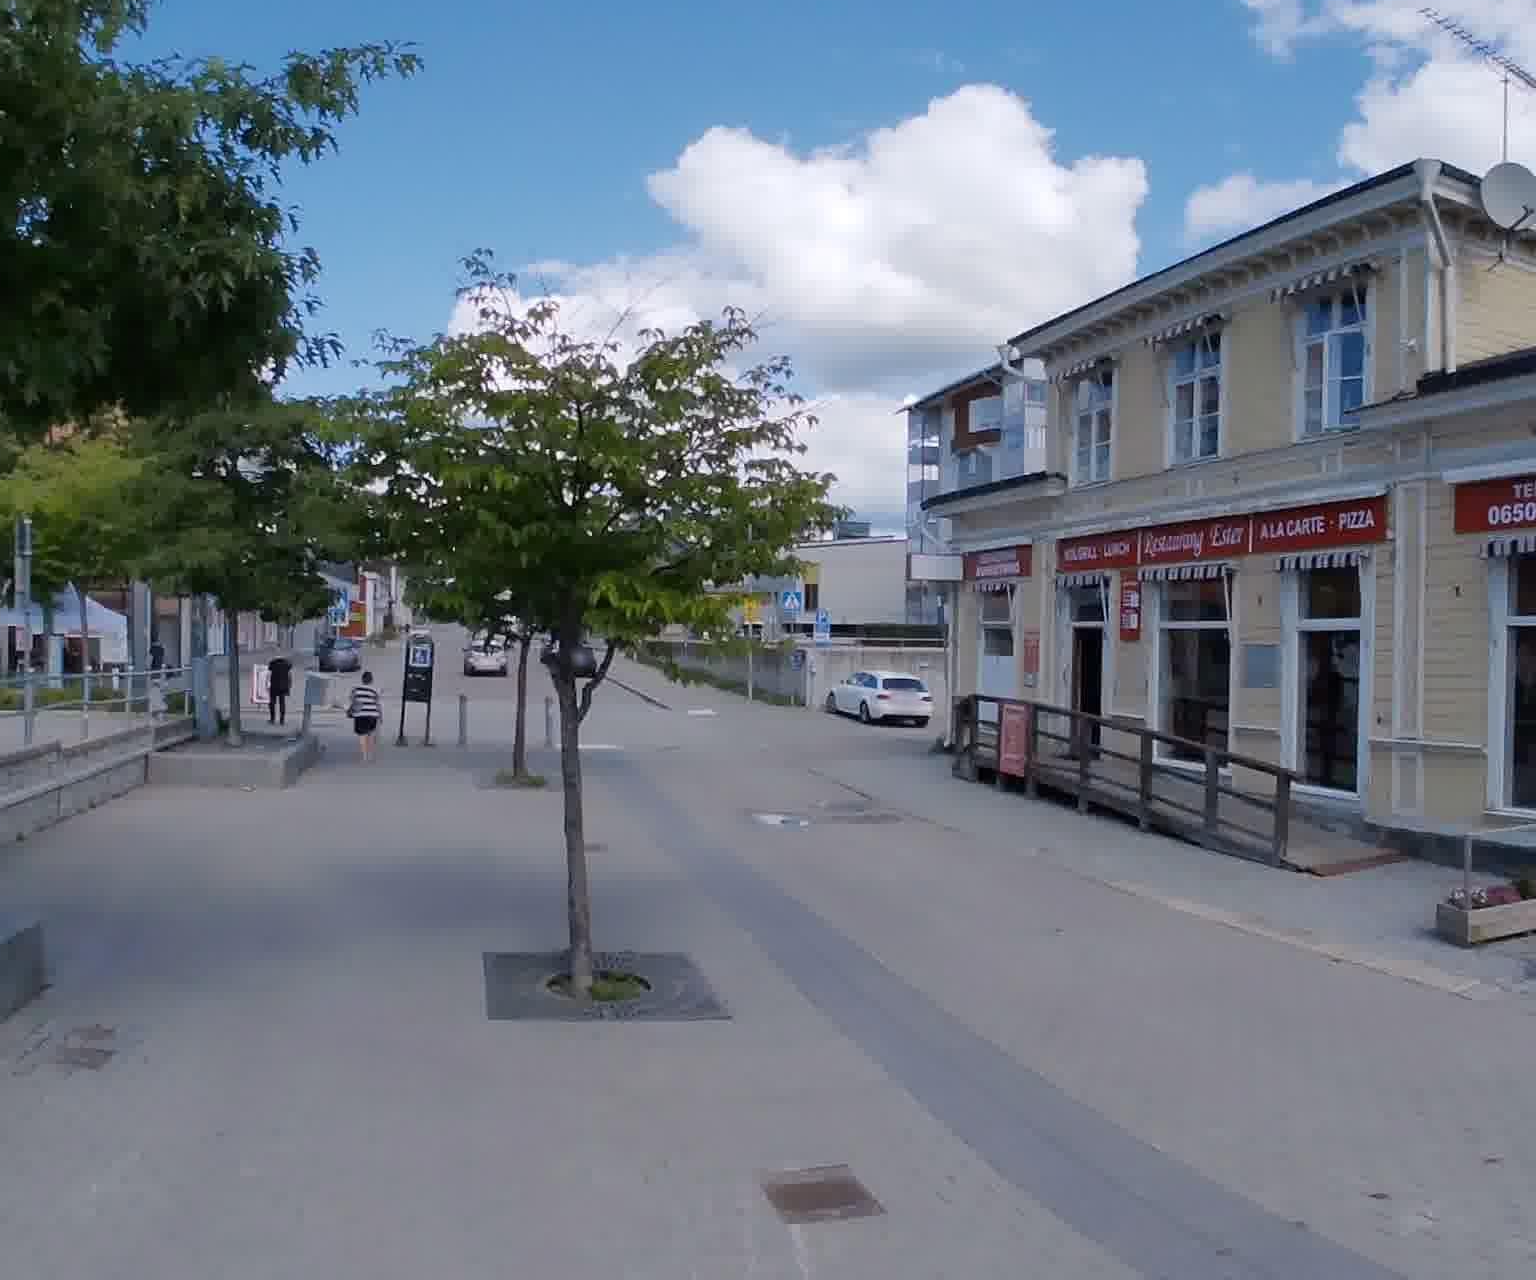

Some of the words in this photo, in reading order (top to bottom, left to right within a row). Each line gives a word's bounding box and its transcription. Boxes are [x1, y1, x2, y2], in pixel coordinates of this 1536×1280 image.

[1286, 516, 1325, 537] CARTE
[1338, 509, 1376, 530] PIZZA
[1144, 530, 1204, 558] Restaurang
